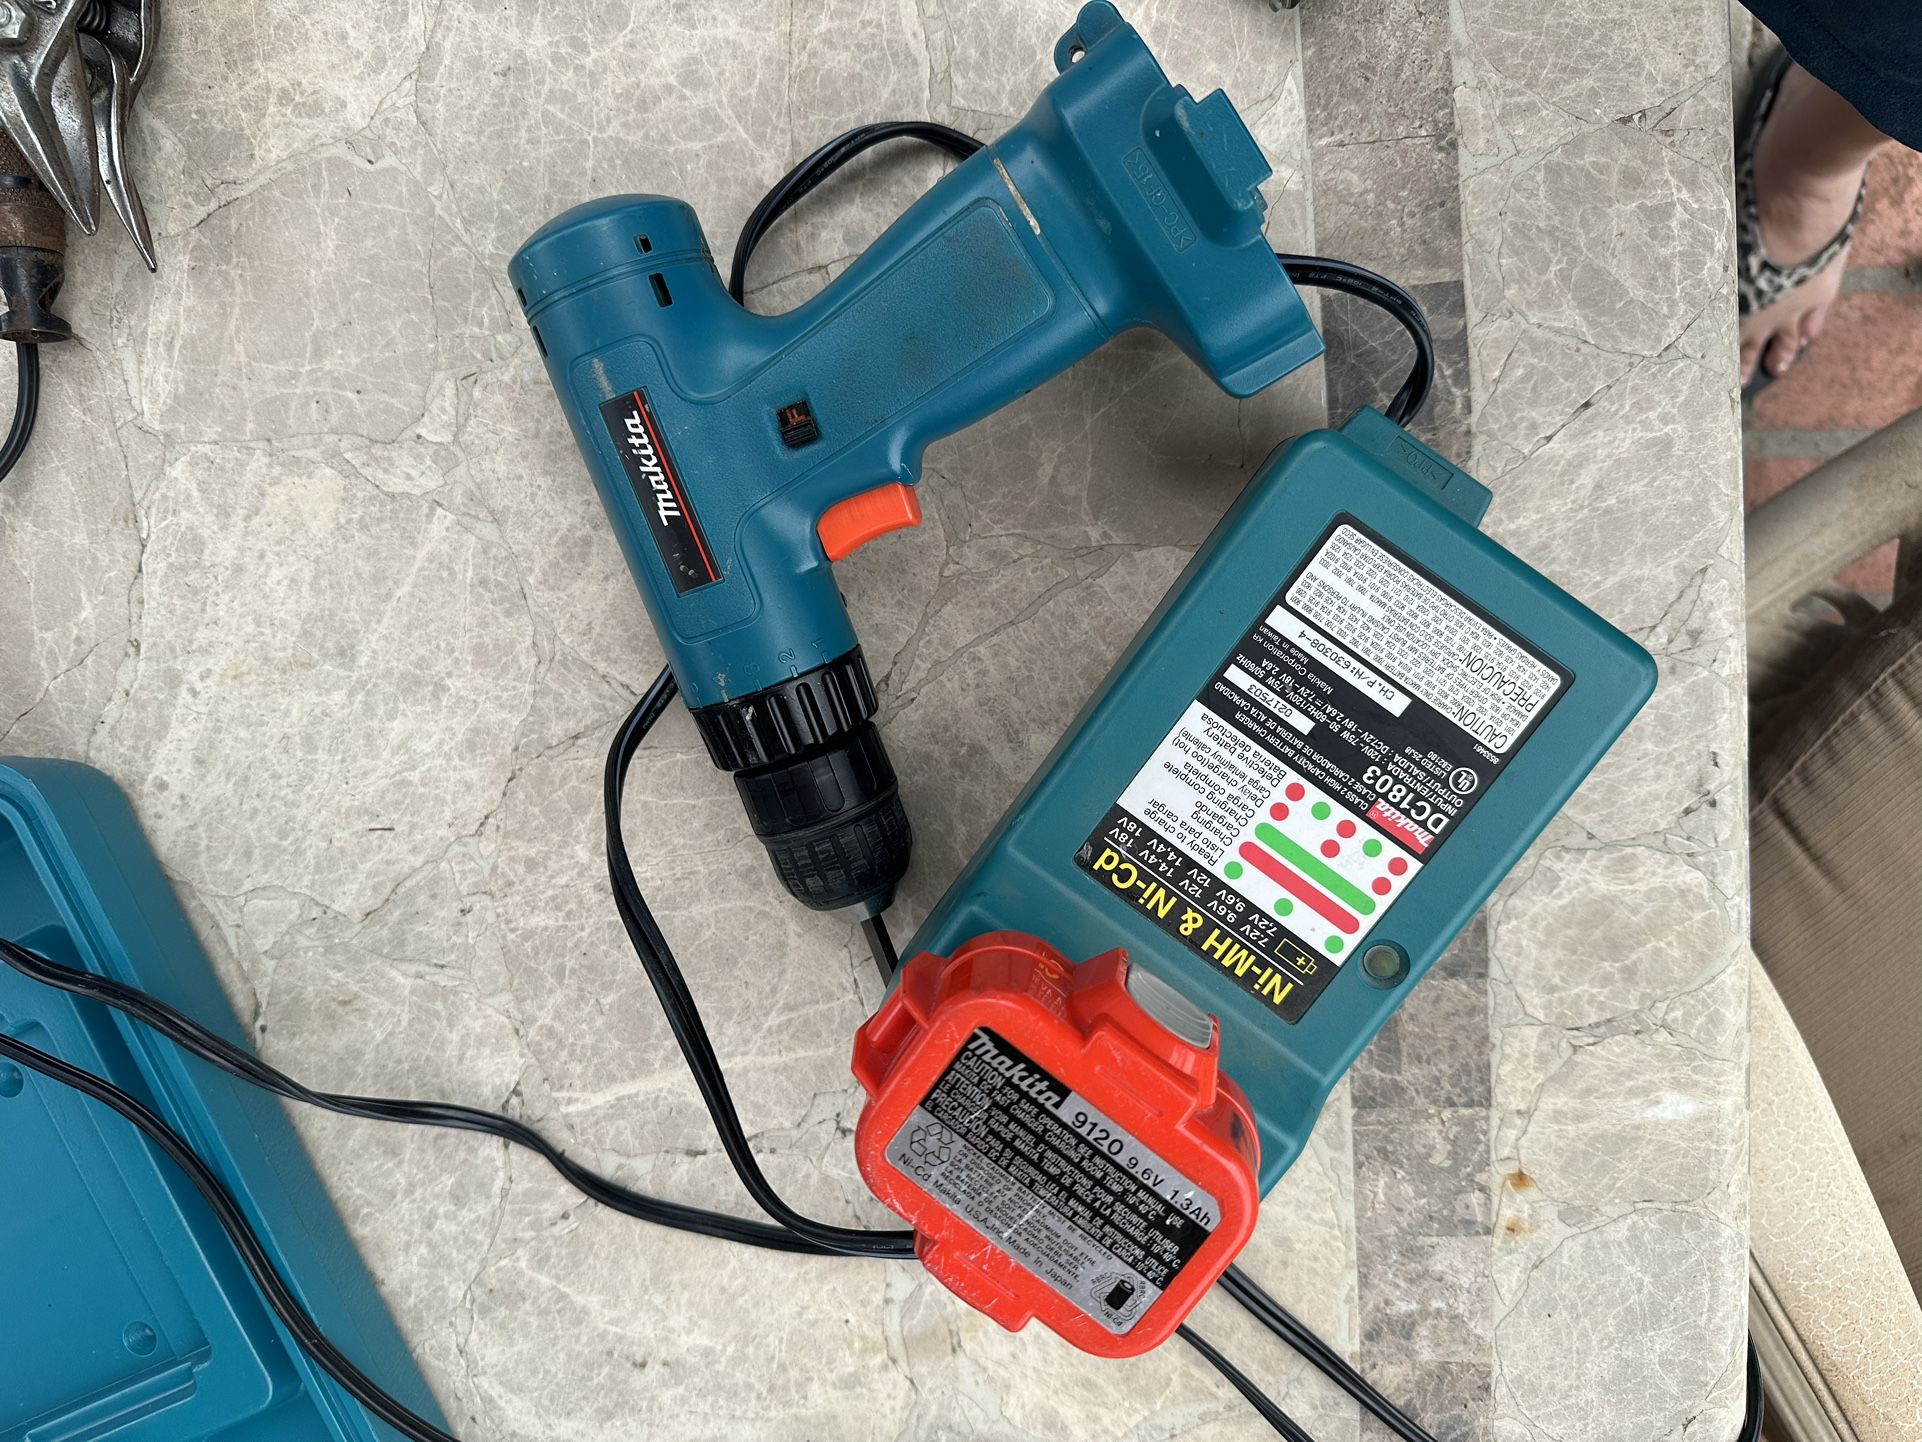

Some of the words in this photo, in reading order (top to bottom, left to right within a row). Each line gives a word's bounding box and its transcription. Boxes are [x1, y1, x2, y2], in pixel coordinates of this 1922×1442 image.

[623, 409, 680, 526] makita
[1252, 632, 1263, 643] KR
[1258, 624, 1281, 645] Taiwan
[1281, 641, 1290, 650] in
[1235, 652, 1265, 678] 50/60Hz
[1261, 657, 1280, 675] 2,6A
[1262, 640, 1307, 675] Corporation
[1289, 647, 1309, 664] Made
[1264, 675, 1284, 692] 75W
[1306, 671, 1333, 695] Makita
[1382, 661, 1405, 680] BATTERY
[1403, 675, 1422, 691] MAKITA
[1460, 650, 1539, 713] PRECAUCION
[1214, 681, 1251, 710] CAPACIDAD
[1246, 683, 1293, 717] 0217503
[1419, 687, 1433, 700] ONLY
[1430, 695, 1453, 713] CHARGE
[1234, 710, 1267, 737] CHARGER
[1249, 705, 1267, 721] ALTA
[1264, 717, 1277, 729] DE
[1177, 726, 1211, 753] caliente)
[1200, 712, 1251, 752] defectuosa
[1339, 729, 1359, 746] 75W
[1453, 704, 1507, 749] CAUTION
[1171, 734, 1191, 754] hot)
[1202, 726, 1237, 756] battery
[1264, 733, 1295, 757] BATTERY
[1301, 744, 1314, 756] DE
[1163, 760, 1205, 794] complete
[1183, 761, 1226, 795] completa
[1236, 749, 1283, 788] Defective
[1292, 753, 1326, 779] CAPACITY
[1311, 751, 1350, 781] CARGADOR
[1420, 757, 1447, 779] LISTED
[1244, 776, 1271, 799] Carga
[1323, 775, 1342, 791] HIGH
[1339, 786, 1348, 794] 2
[1347, 777, 1355, 785] 2
[1351, 780, 1376, 800] CLASE
[1386, 761, 1458, 816] INPUT/ENTRADA
[1393, 752, 1463, 807] OUTPUT/SALIDA
[1205, 790, 1250, 827] Charging
[1223, 792, 1255, 818] Carga
[1237, 783, 1266, 808] Delay
[1344, 790, 1368, 810] CLASS
[1362, 765, 1450, 834] DC1803
[1143, 807, 1176, 833] charge
[1147, 798, 1178, 822] cargar
[1194, 800, 1240, 837] Cargando
[1375, 797, 1434, 847] makita
[1108, 827, 1133, 847] 18V
[1116, 816, 1142, 836] 18V
[1176, 831, 1187, 843] to
[1178, 819, 1203, 841] para
[1190, 809, 1234, 846] Charging
[1146, 838, 1182, 866] 14,4V
[1186, 838, 1220, 866] Ready
[1201, 836, 1225, 858] Listo
[1137, 848, 1174, 877] 14.4V
[1092, 847, 1177, 919] Ni-Cd
[1178, 878, 1202, 898] 12V
[1186, 867, 1211, 887] 12V
[1206, 899, 1237, 923] 9.6V
[1215, 888, 1245, 912] 9,6V
[1178, 906, 1203, 936] &
[1247, 913, 1277, 936] 7,2V
[1238, 923, 1269, 947] 7.2V
[1200, 927, 1294, 1005] Ni-MH
[960, 1050, 1006, 1089] CAUTION
[967, 1027, 1061, 1112] makita
[944, 1070, 992, 1110] ATTENTION
[953, 1061, 980, 1084] MAKITA
[978, 1080, 992, 1093] DC
[990, 1089, 1011, 1107] FAST
[1044, 1131, 1081, 1162] CHARGING
[1079, 1158, 1104, 1179] ROOM
[1071, 1111, 1124, 1156] 9120
[897, 1152, 932, 1182] Ni-Cd
[932, 1178, 961, 1205] Makita
[1125, 1156, 1165, 1187] 9.6V
[1169, 1189, 1211, 1226] 1.3Ah
[1004, 1235, 1030, 1258] Made
[1044, 1267, 1073, 1290] Japan
